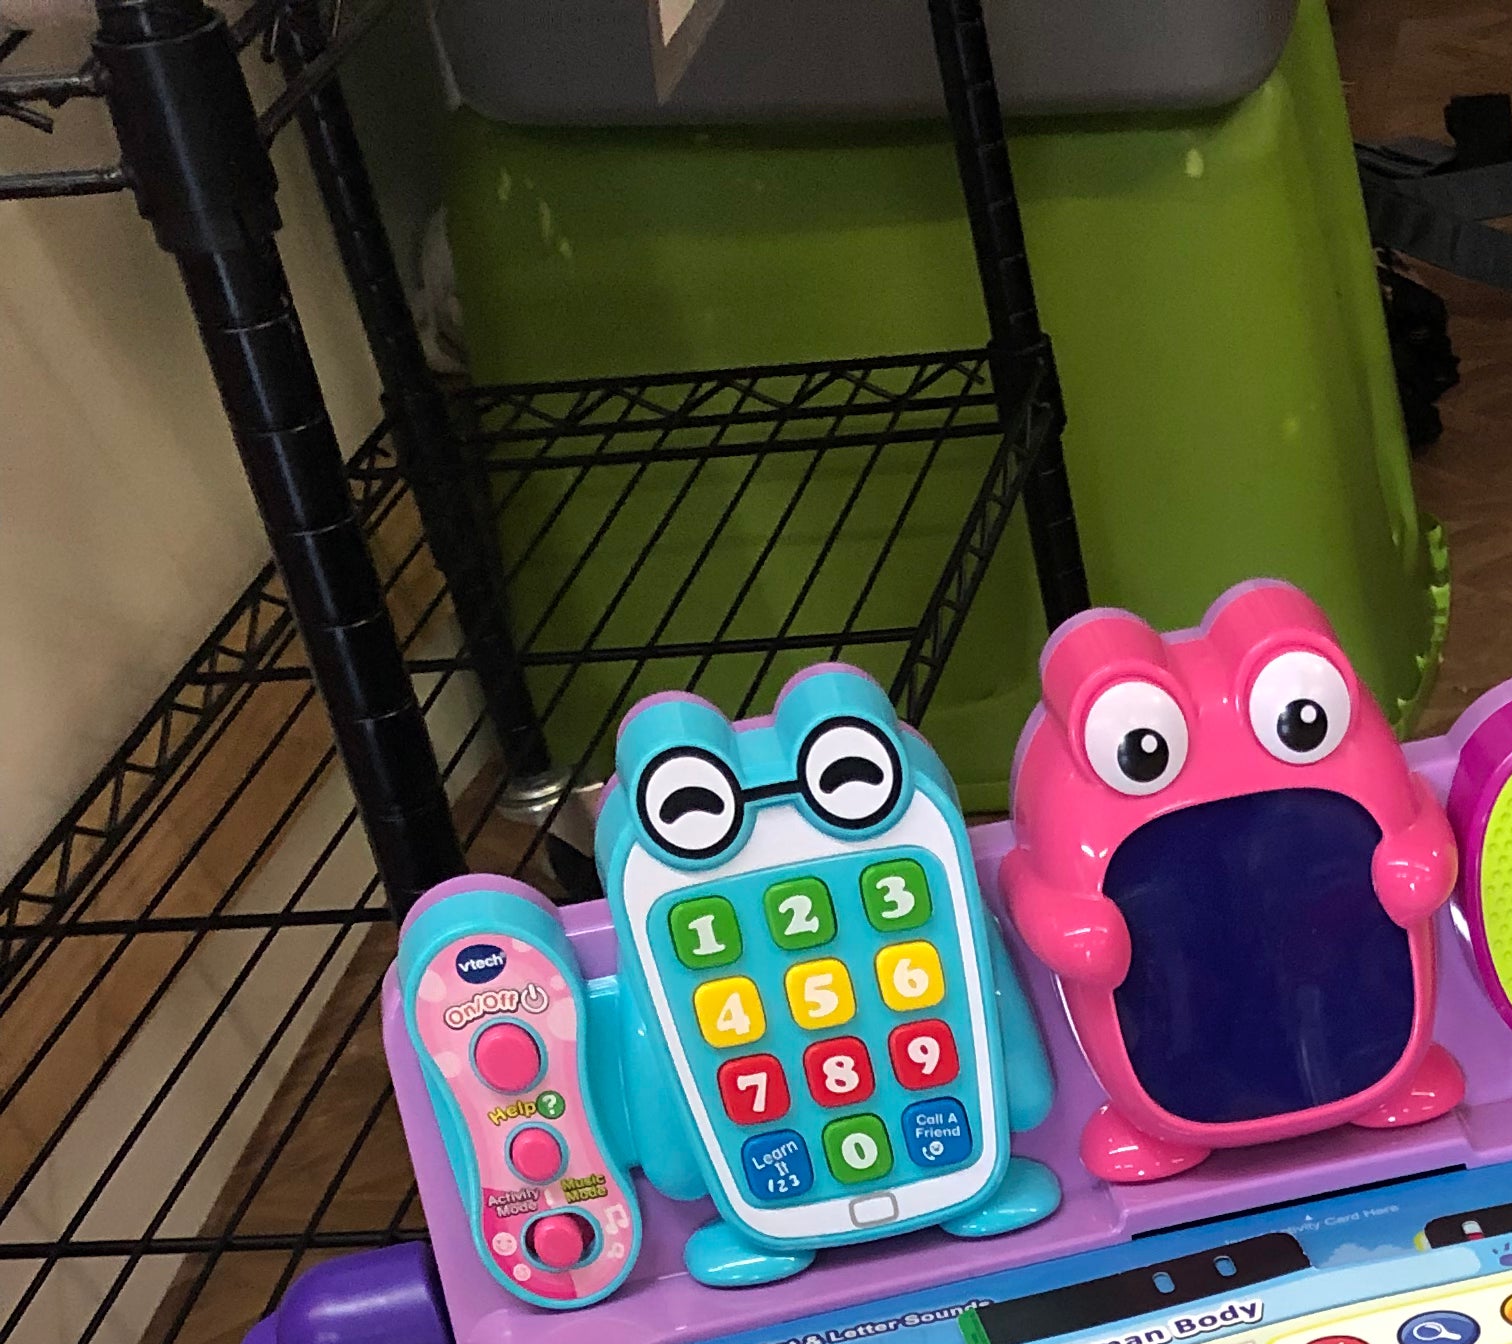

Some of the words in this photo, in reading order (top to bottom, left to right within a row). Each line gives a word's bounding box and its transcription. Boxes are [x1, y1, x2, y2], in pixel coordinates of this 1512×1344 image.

[876, 876, 915, 918] 3
[778, 895, 819, 936] 2
[688, 915, 725, 955] 1
[457, 952, 504, 974] vtech
[893, 958, 929, 998] 6
[804, 973, 839, 1018] 5
[716, 993, 751, 1035] 4
[906, 1036, 941, 1075] 9
[822, 1055, 859, 1093] 8
[737, 1071, 768, 1113] 7
[488, 1100, 537, 1126] Help
[915, 1113, 945, 1127] Call
[947, 1112, 958, 1125] A
[915, 1125, 961, 1139] Friend
[752, 1140, 799, 1171] Learn
[841, 1132, 878, 1170] 0
[562, 1174, 605, 1193] Music
[776, 1161, 790, 1177] It
[488, 1188, 539, 1209] Activity
[497, 1200, 538, 1218] Mode
[566, 1184, 607, 1203] Mode
[1324, 1212, 1360, 1227] Card
[1363, 1204, 1399, 1218] Here
[1175, 1299, 1258, 1334] Body
